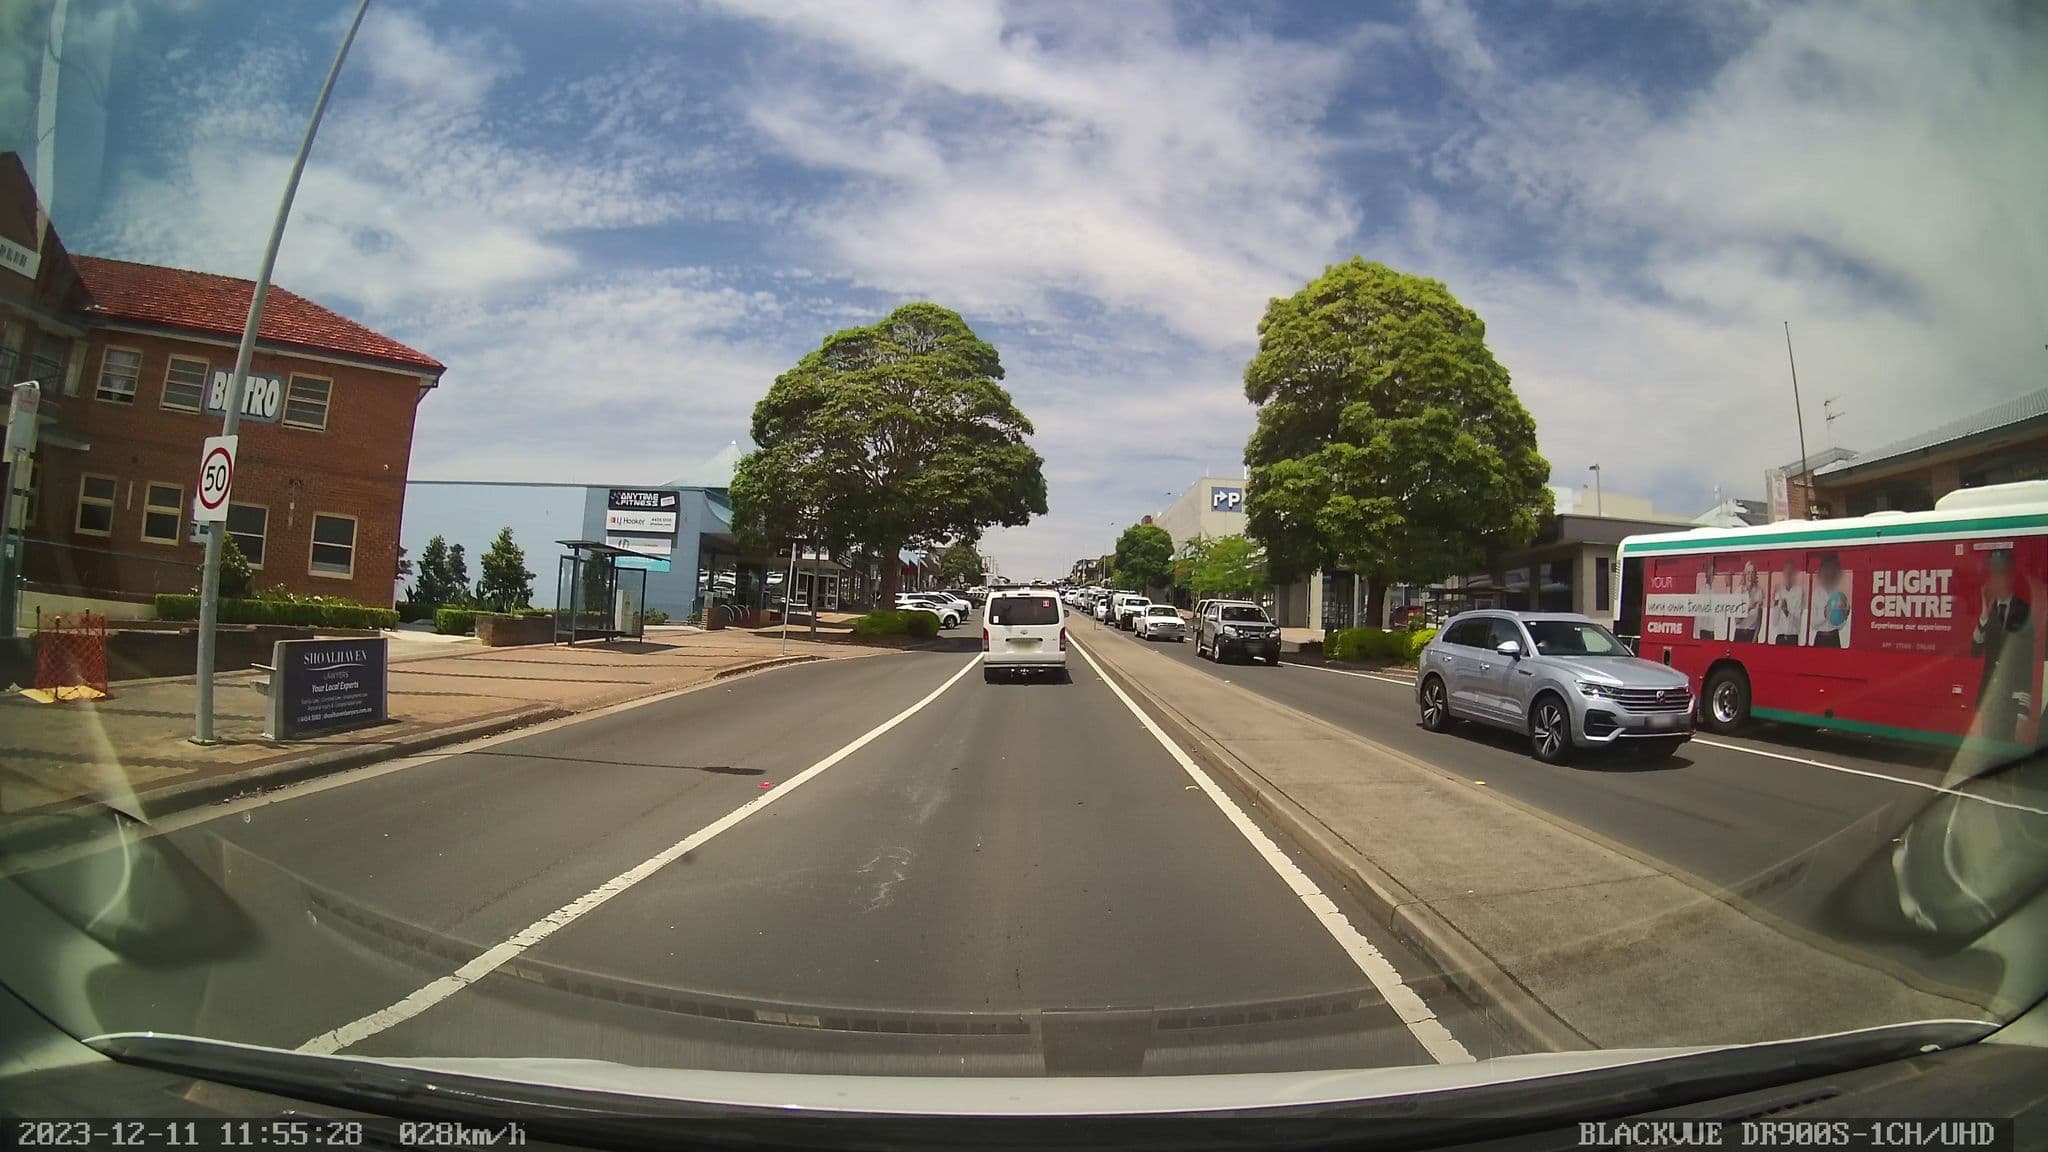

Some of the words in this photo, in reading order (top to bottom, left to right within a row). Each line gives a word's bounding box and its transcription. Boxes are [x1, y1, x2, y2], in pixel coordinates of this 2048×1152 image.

[209, 371, 280, 418] BITRO
[204, 465, 227, 492] 50
[620, 492, 659, 500] ANYTIME
[623, 517, 646, 525] Hooker
[1650, 576, 1672, 588] YOUR
[1872, 569, 1952, 593] FLIGHT
[1687, 599, 1712, 612] travel
[1870, 595, 1952, 618] CENTRE
[1647, 622, 1682, 634] CENTRE
[1870, 621, 1904, 631] Experience
[303, 649, 368, 664] SHOALHAVEN
[312, 684, 325, 693] Your
[325, 683, 340, 692] Local
[340, 681, 359, 691] Experts
